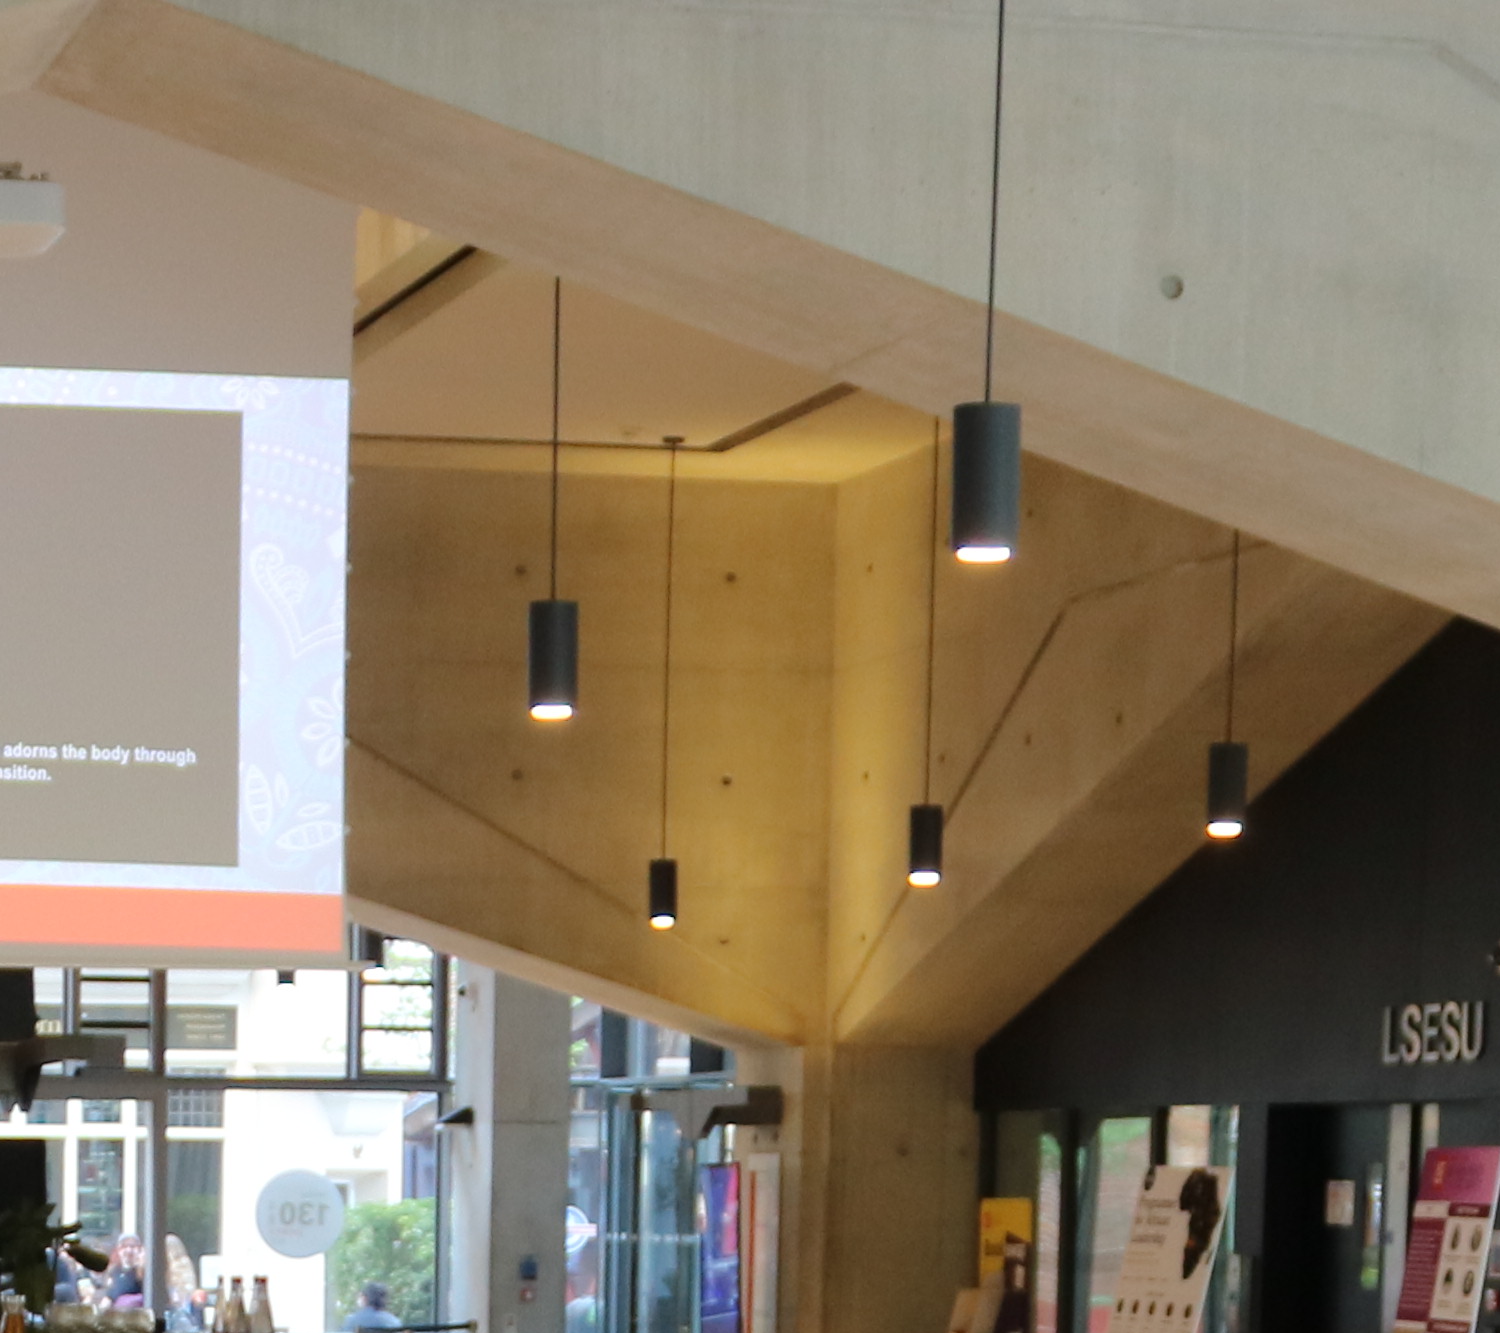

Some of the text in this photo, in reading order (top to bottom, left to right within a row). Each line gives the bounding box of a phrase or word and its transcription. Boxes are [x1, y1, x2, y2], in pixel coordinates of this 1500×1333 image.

[3, 743, 58, 759] adorns
[62, 744, 87, 760] the
[91, 745, 131, 765] body
[134, 747, 197, 767] through
[1382, 1000, 1485, 1065] LSESU
